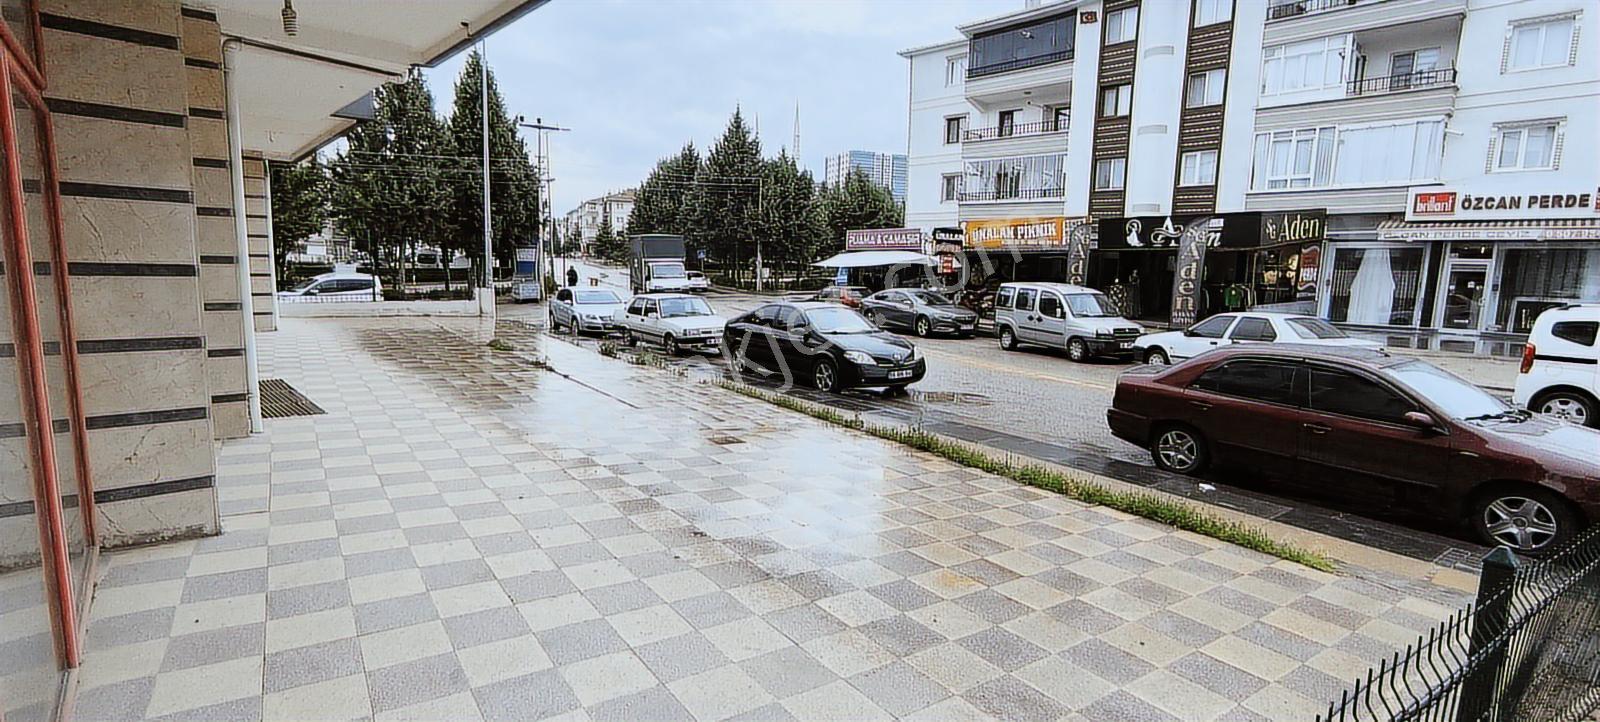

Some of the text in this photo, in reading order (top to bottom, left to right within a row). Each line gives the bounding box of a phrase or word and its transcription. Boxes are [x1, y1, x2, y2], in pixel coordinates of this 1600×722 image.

[1461, 193, 1591, 210] ÖZCAN PERDE
[1279, 214, 1319, 240] Aden
